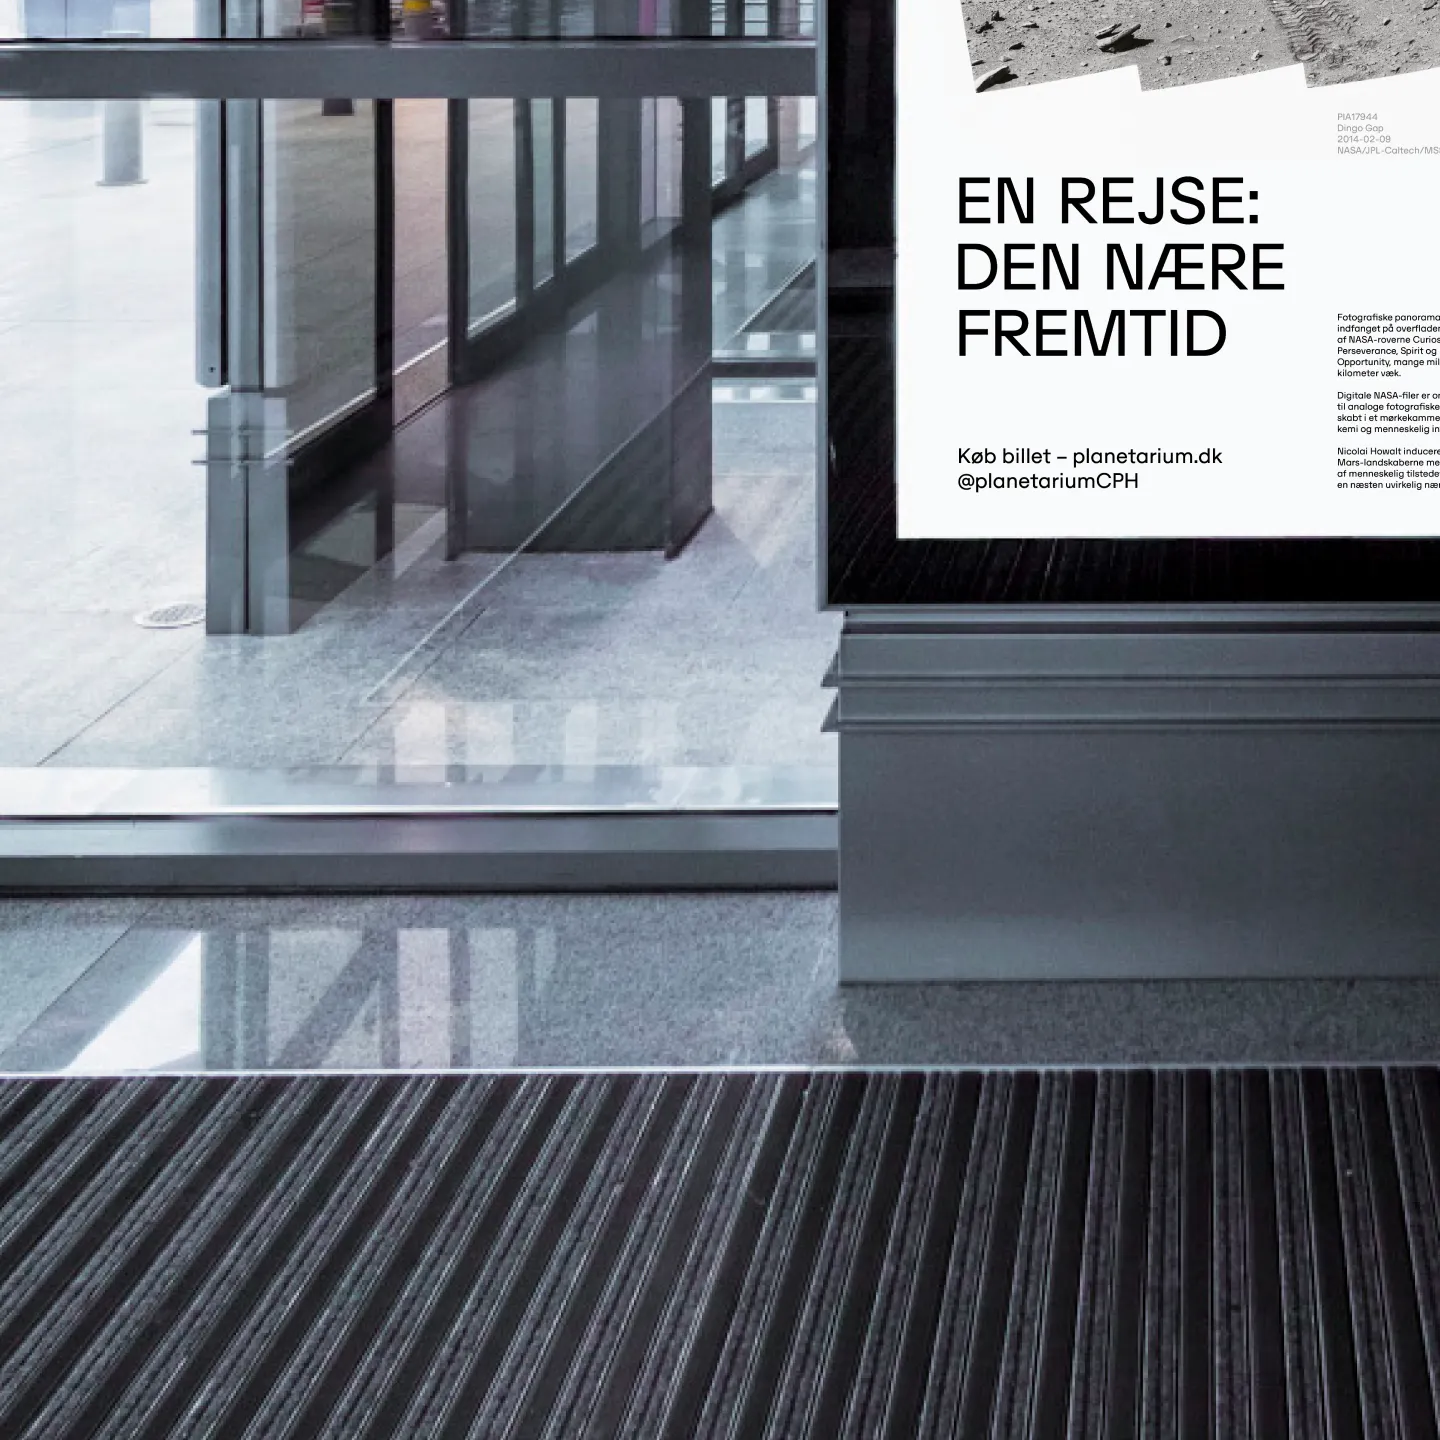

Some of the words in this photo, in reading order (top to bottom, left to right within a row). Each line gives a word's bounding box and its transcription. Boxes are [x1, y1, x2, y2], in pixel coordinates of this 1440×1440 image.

[1337, 123, 1364, 134] Dingo
[1365, 123, 1384, 134] Gap
[959, 177, 1033, 223] EN
[1062, 176, 1258, 225] REJSE:
[958, 244, 1079, 290] DEN
[1107, 244, 1284, 290] NÆRE
[1337, 312, 1393, 324] Fotografiske
[959, 310, 1226, 356] FREMTID
[1337, 324, 1381, 335] indfanget
[1382, 322, 1394, 335] på
[1336, 335, 1348, 344] af
[1348, 335, 1411, 344] NASA-roverne
[1337, 346, 1399, 356] Perseverance,
[1400, 346, 1425, 357] Spirit
[1425, 348, 1438, 357] og
[1336, 357, 1392, 368] Opportunity,
[1393, 359, 1425, 368] mange
[1337, 368, 1380, 378] kilometer
[1380, 368, 1402, 378] væk.
[1337, 391, 1372, 402] Digitale
[1373, 391, 1420, 400] NASA-filer
[1420, 392, 1431, 400] er
[1336, 402, 1346, 411] til
[1347, 402, 1385, 413] analoge
[1385, 402, 1440, 413] fotografiske
[1336, 413, 1363, 422] skabt
[1368, 413, 1379, 422] et
[1337, 424, 1359, 433] kemi
[1360, 426, 1372, 436] og
[1374, 424, 1430, 436] menneskelig
[1337, 446, 1368, 456] Nicolai
[1370, 447, 1402, 456] Howalt
[959, 448, 996, 464] Køb
[1003, 448, 1051, 463] billet
[1074, 448, 1222, 468] planetarium.dk
[1337, 458, 1425, 467] Mars-landskaberne
[1336, 469, 1348, 478] af
[1348, 469, 1405, 480] menneskelig
[958, 473, 1138, 492] @planetariumCPH
[1350, 480, 1384, 489] næsten
[1385, 480, 1423, 491] uvirkelig
